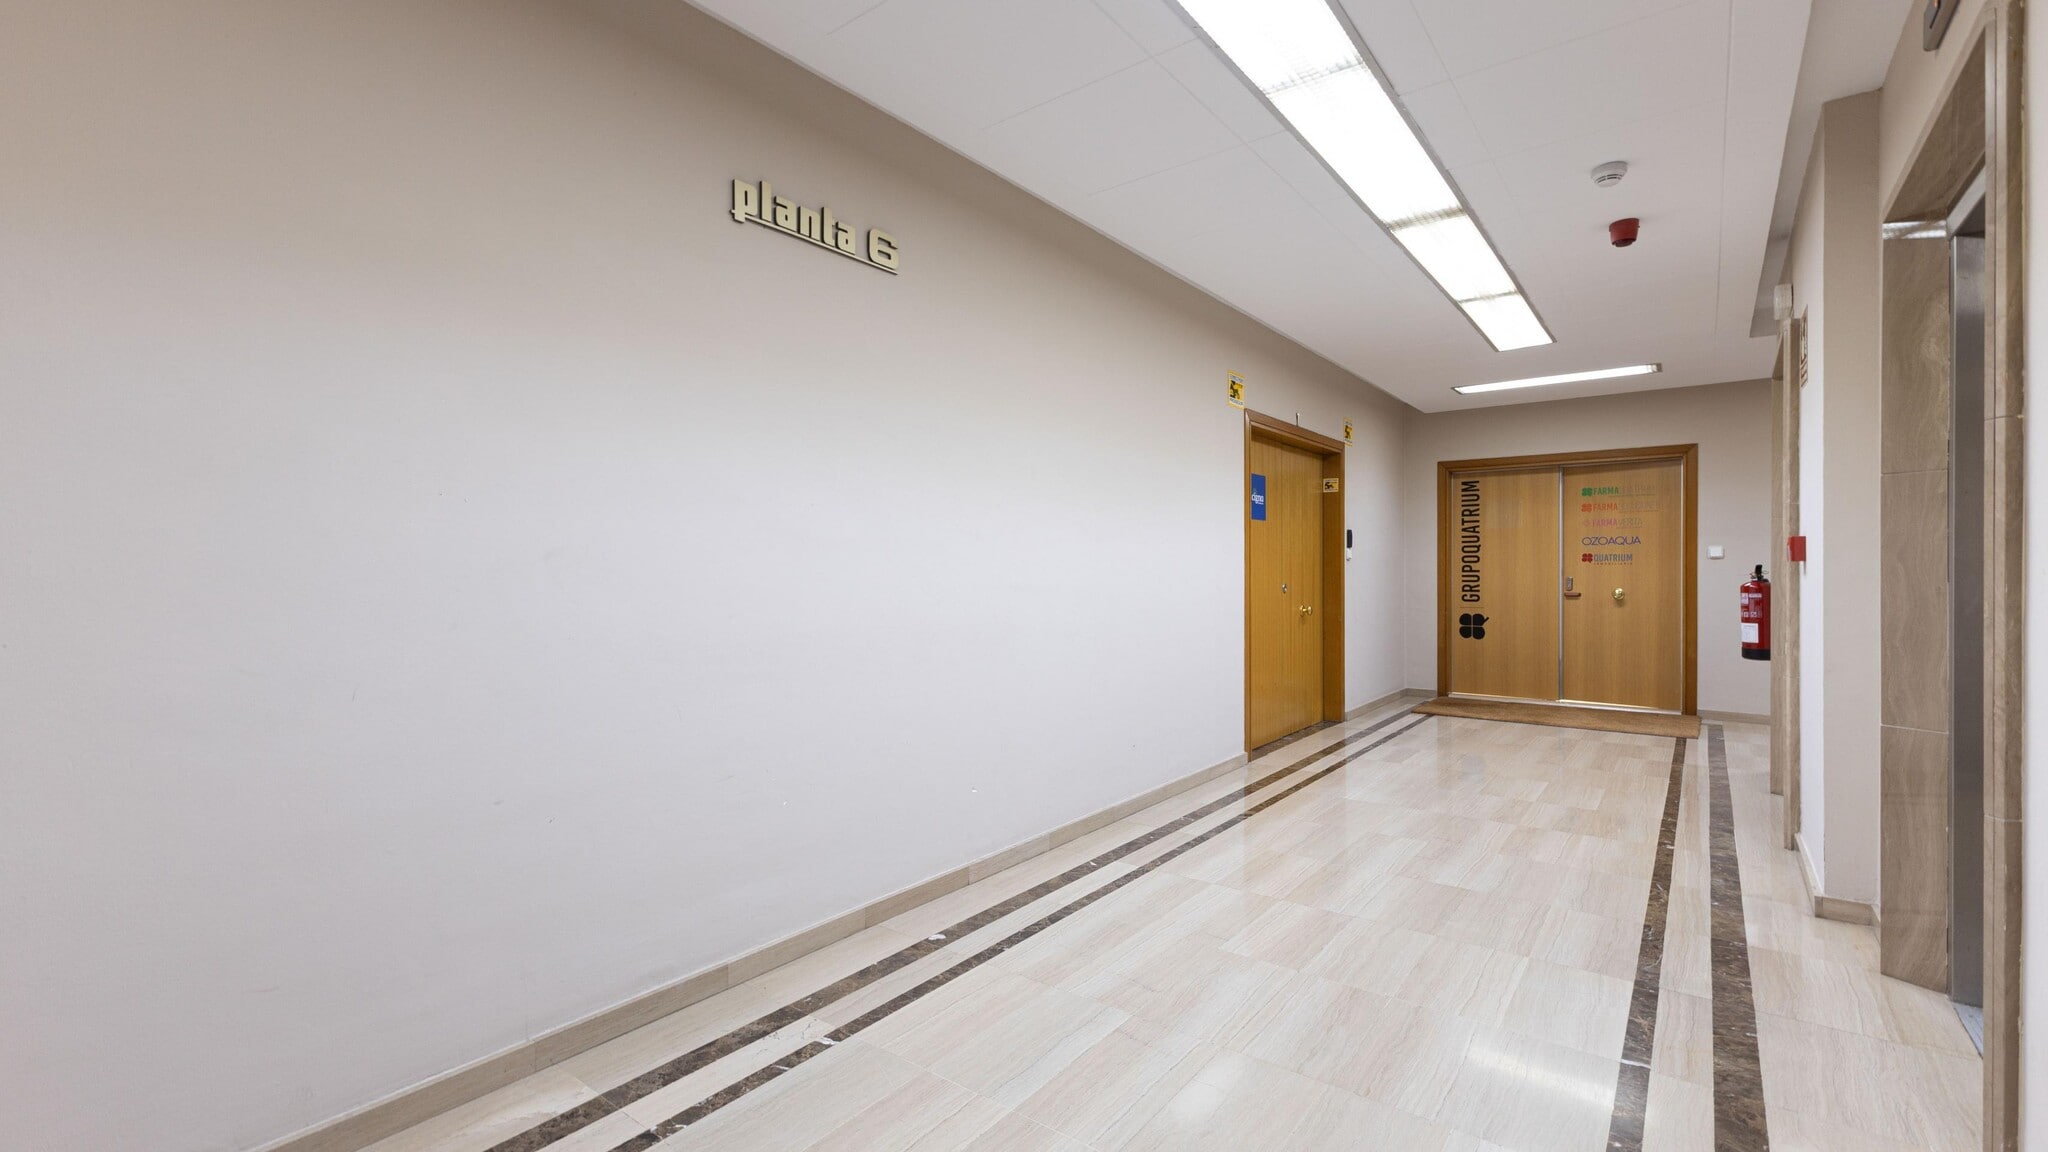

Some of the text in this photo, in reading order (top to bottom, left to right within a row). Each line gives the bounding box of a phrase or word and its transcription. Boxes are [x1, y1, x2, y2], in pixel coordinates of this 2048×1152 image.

[731, 179, 899, 270] planta 6
[1461, 480, 1482, 603] GRUPOQUATRIUM
[1582, 536, 1641, 545] OZOAQUA
[1593, 553, 1633, 561] QUATRIUM
